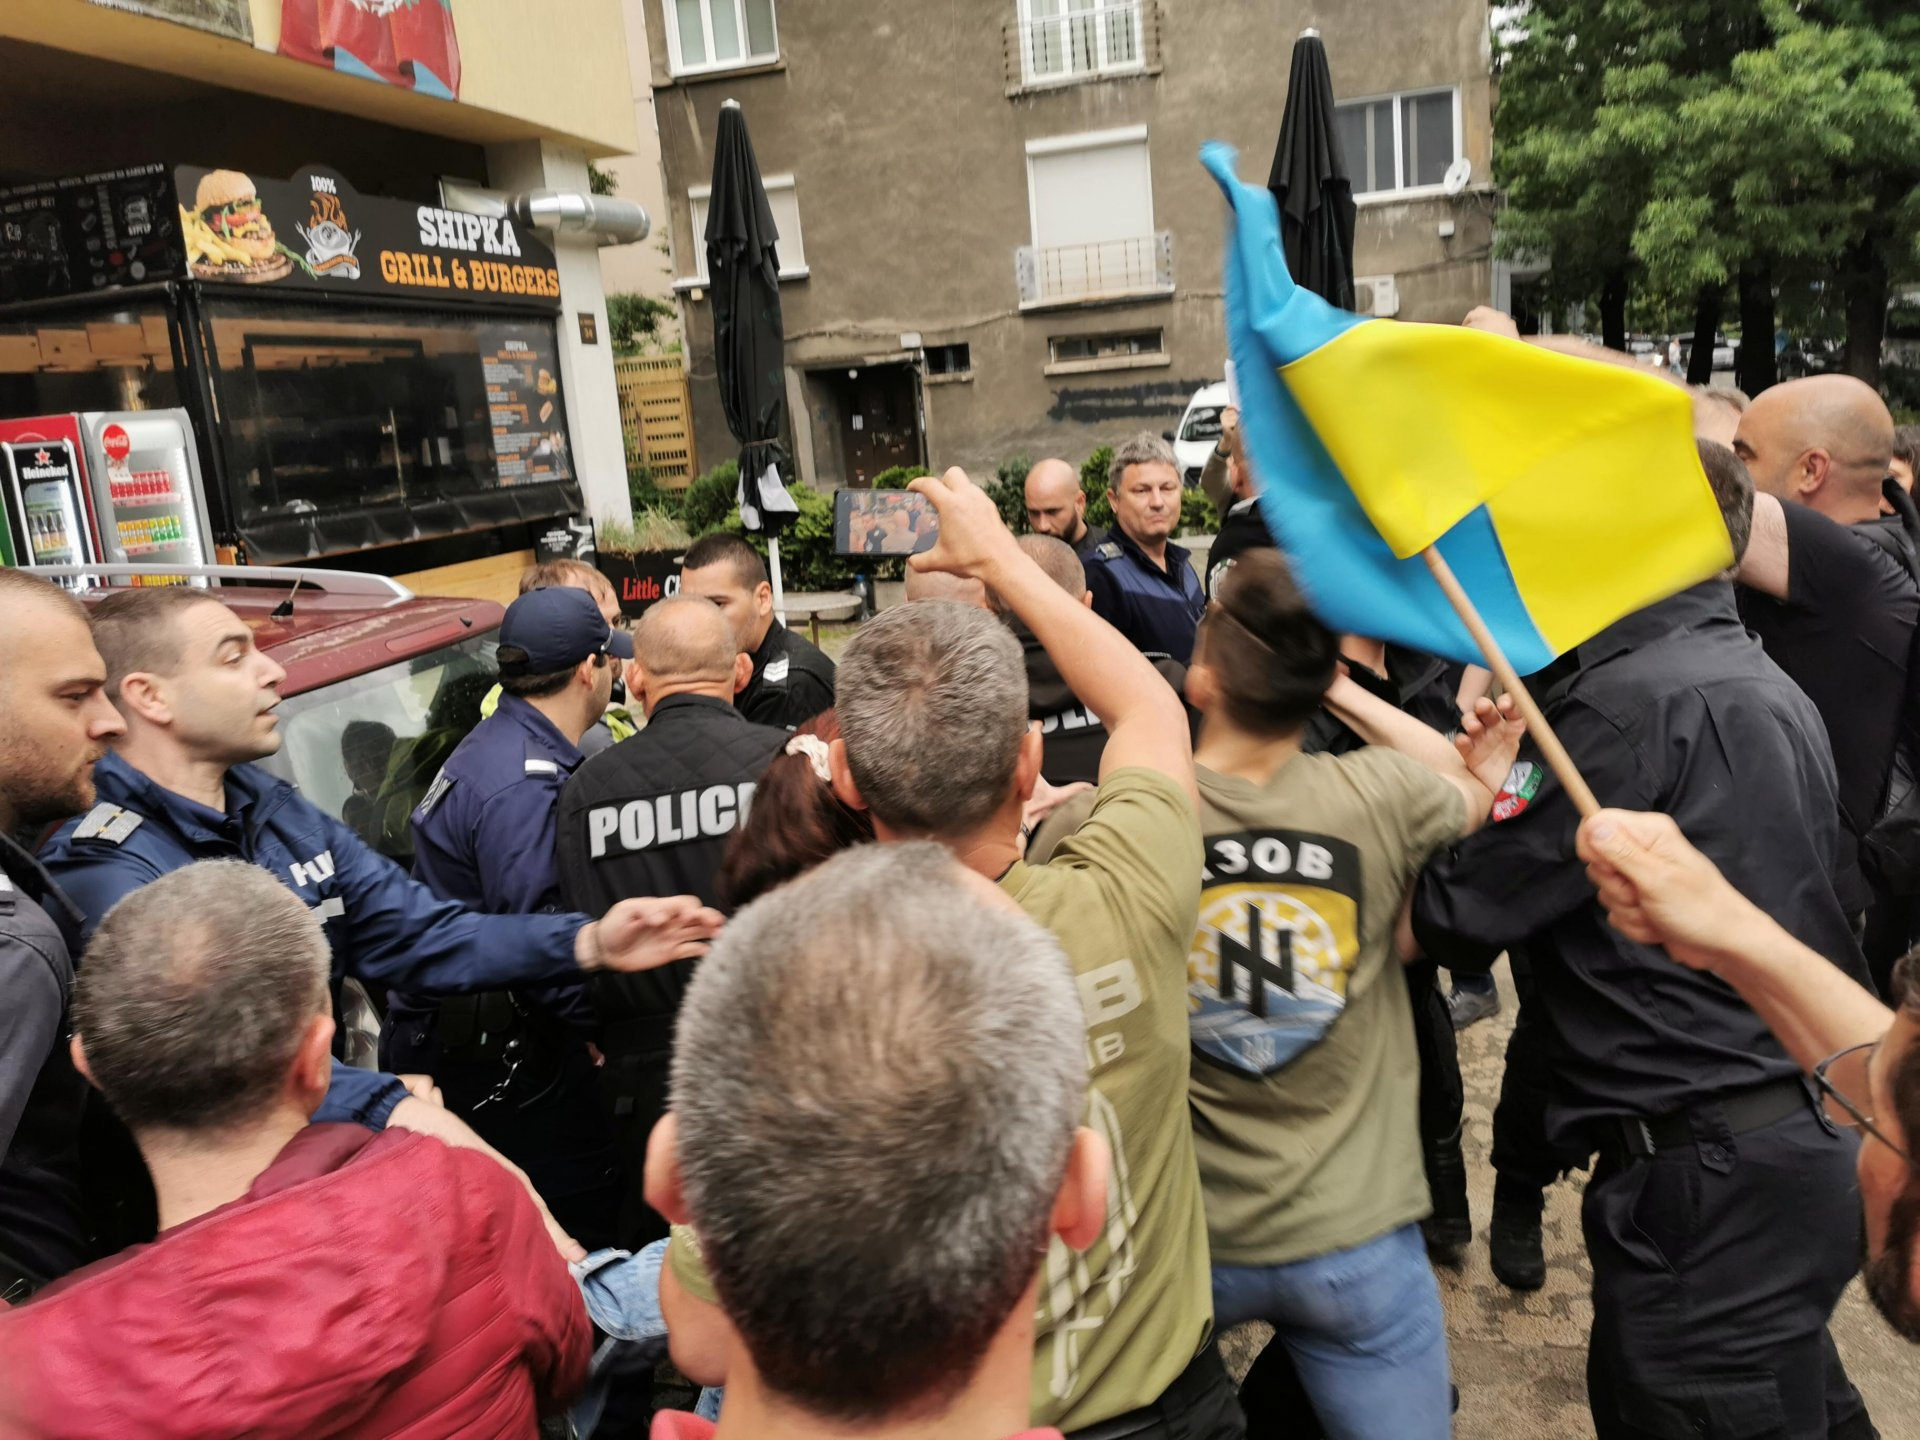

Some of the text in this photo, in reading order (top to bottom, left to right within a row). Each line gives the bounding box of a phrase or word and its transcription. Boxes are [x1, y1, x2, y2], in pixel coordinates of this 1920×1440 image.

[310, 174, 337, 195] 100%
[416, 205, 521, 257] SHIPKA
[380, 250, 560, 297] GRILL & BURGERS
[22, 464, 69, 480] Heineken
[622, 575, 660, 600] Little
[1202, 837, 1334, 882] ЗОВ
